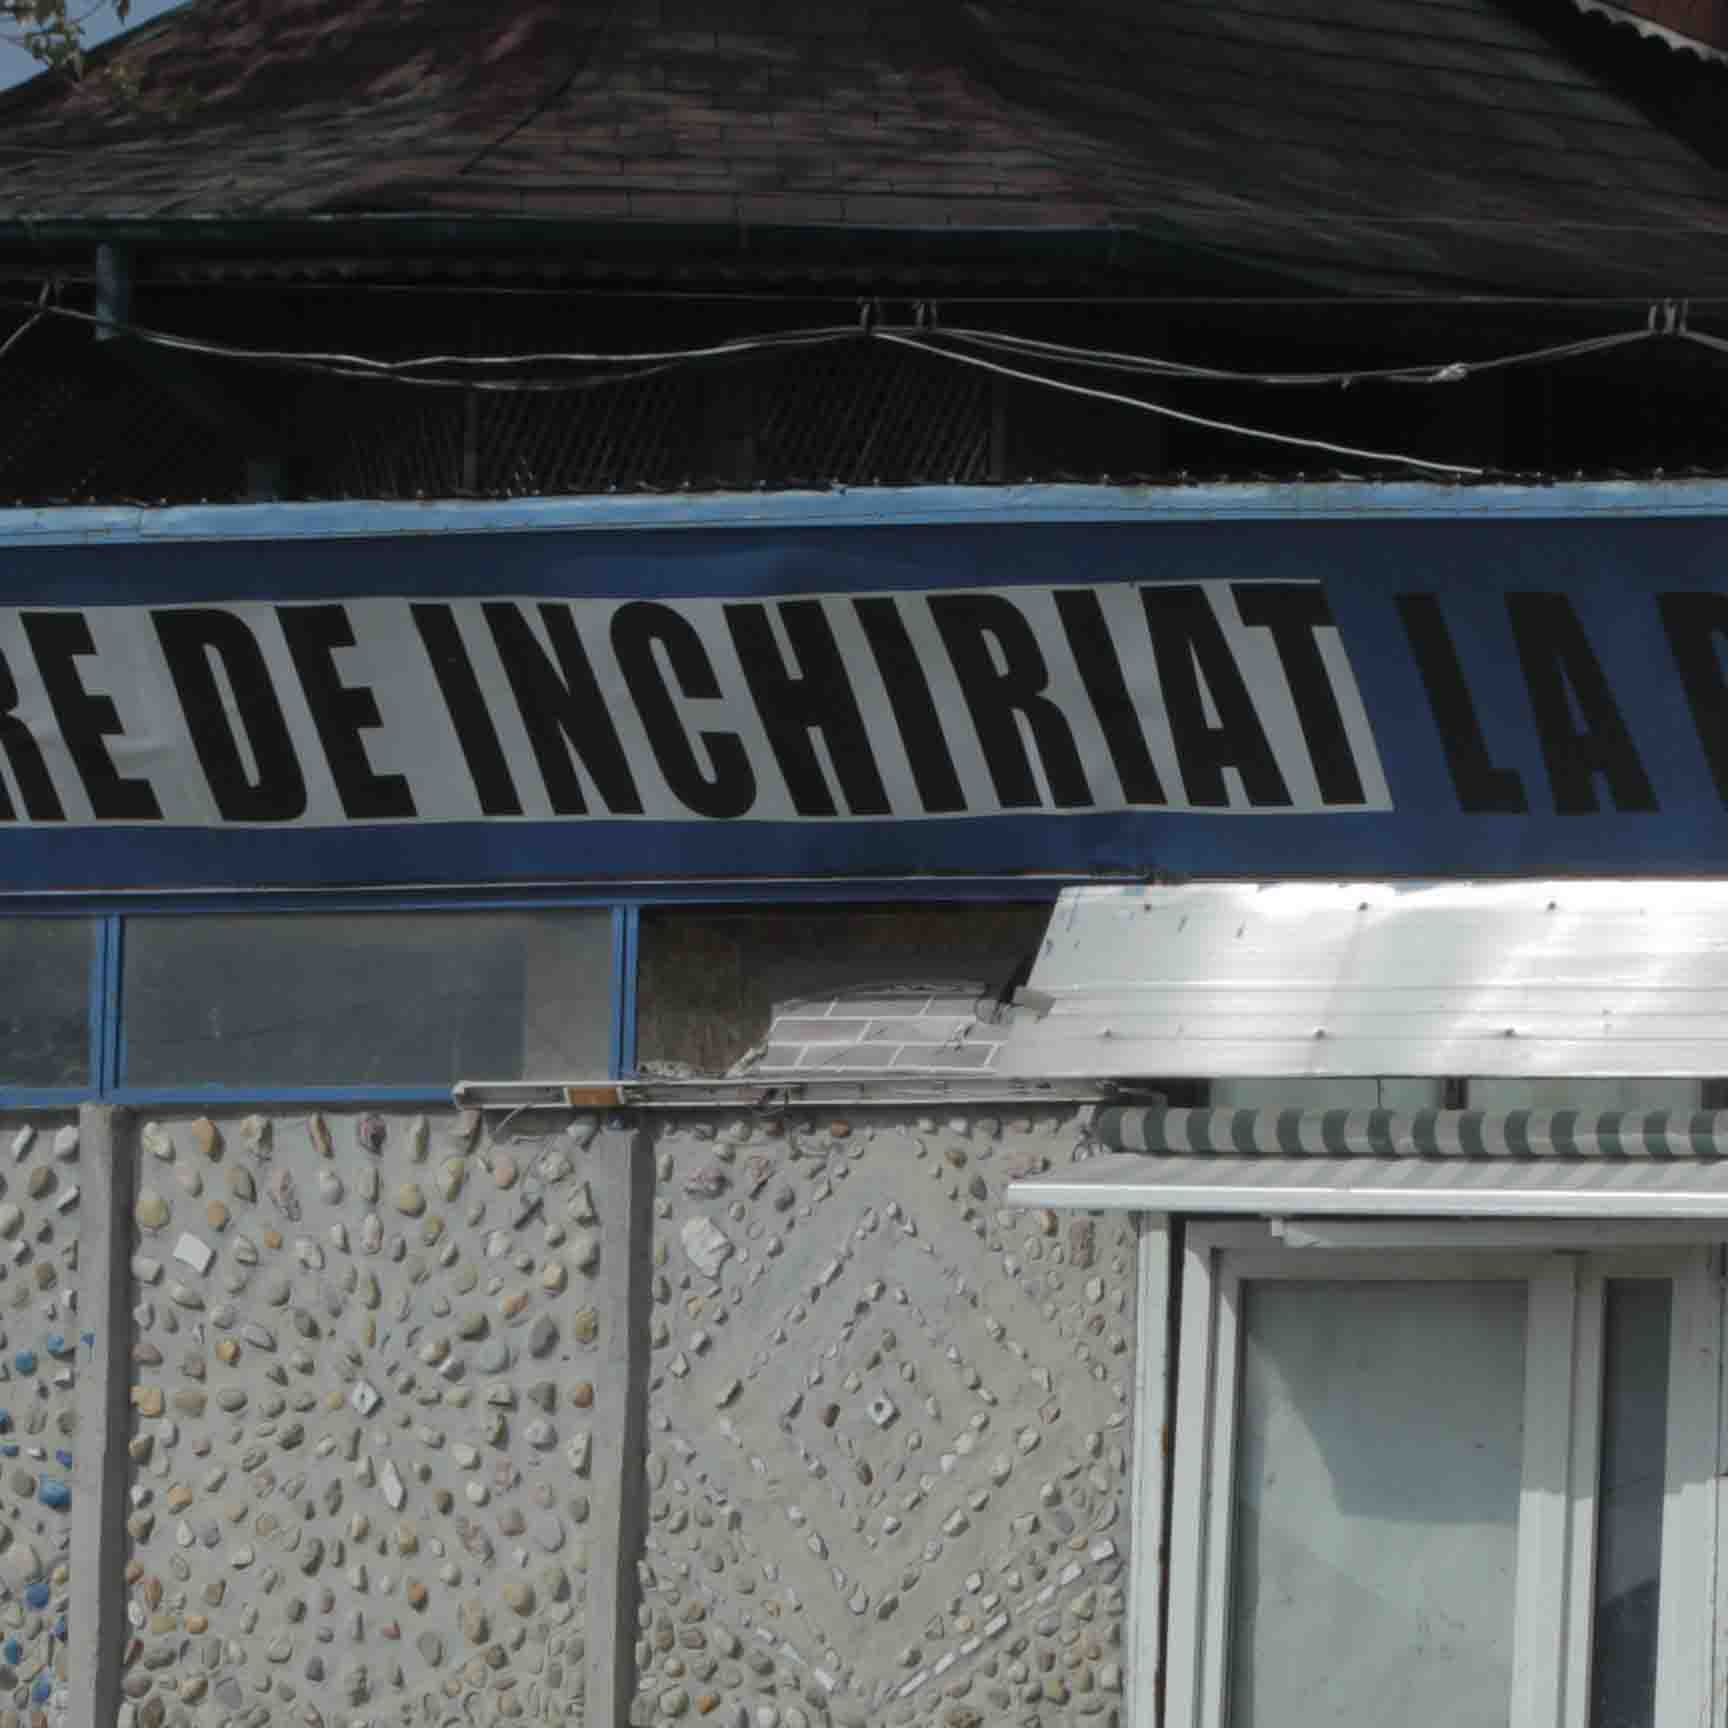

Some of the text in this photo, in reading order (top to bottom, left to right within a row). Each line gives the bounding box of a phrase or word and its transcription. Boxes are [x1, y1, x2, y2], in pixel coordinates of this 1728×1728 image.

[149, 604, 417, 822] DE
[410, 583, 1368, 820] INCHIRIAT
[1396, 591, 1661, 816] LA
